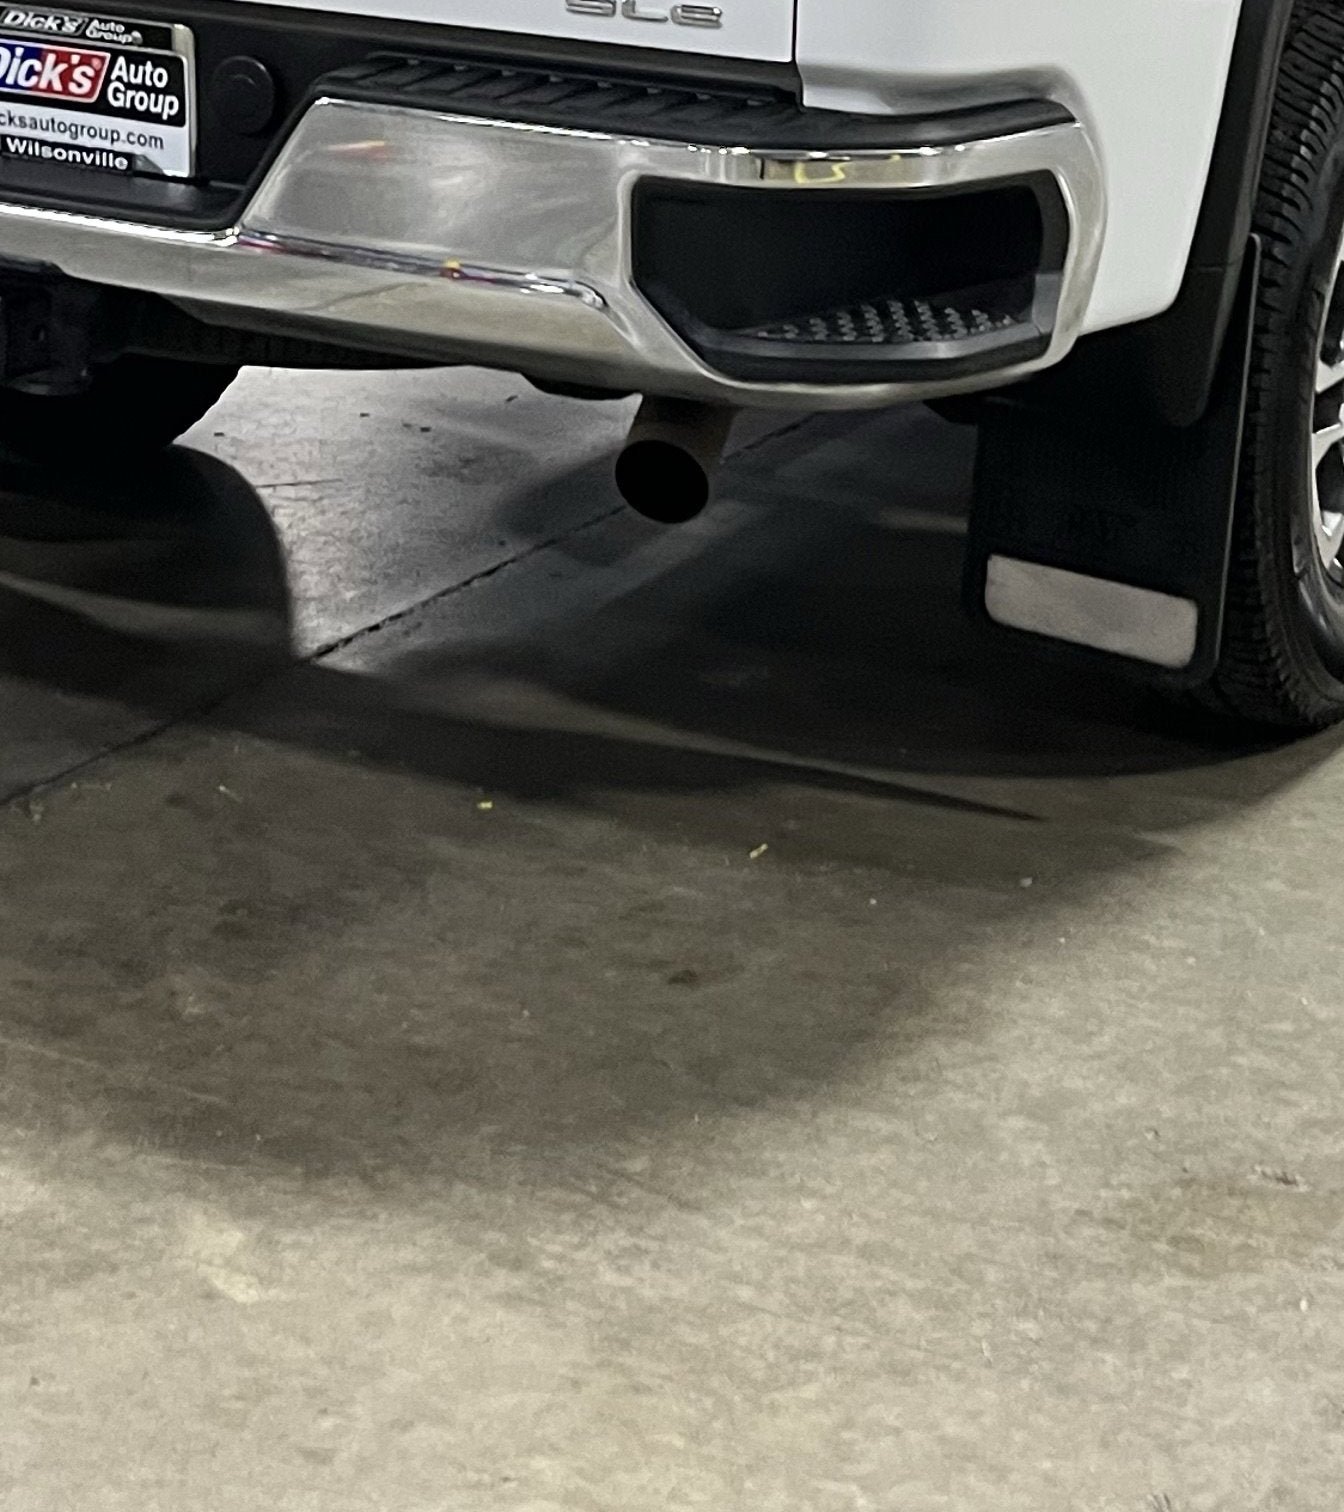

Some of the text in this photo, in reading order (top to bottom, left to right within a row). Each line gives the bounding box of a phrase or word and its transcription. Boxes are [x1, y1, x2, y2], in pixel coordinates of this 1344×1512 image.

[3, 9, 81, 34] Dick's
[89, 19, 126, 33] Auto
[110, 55, 169, 87] Auto
[106, 81, 179, 120] Group
[5, 136, 129, 171] Wilsonville
